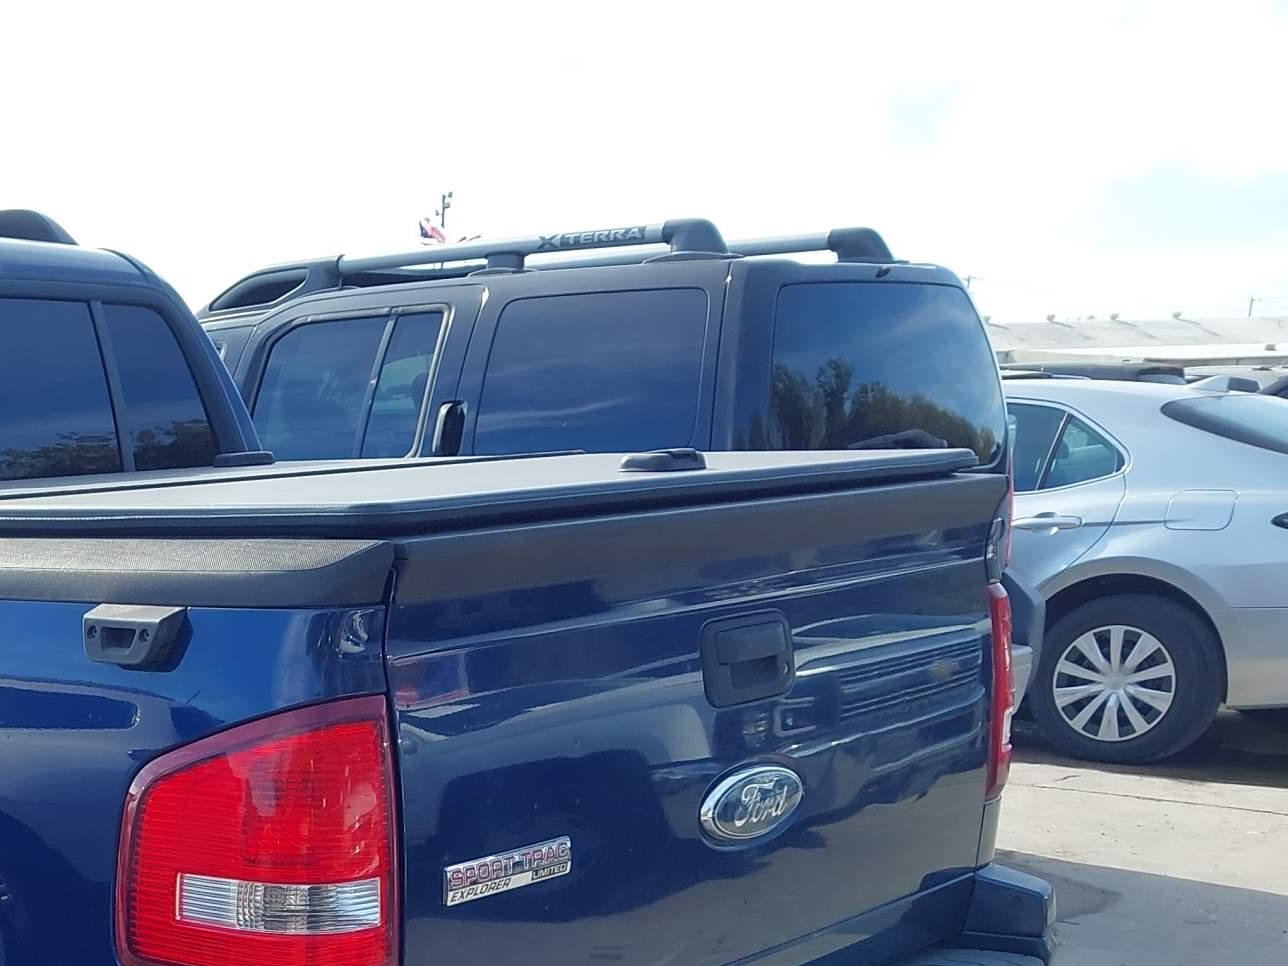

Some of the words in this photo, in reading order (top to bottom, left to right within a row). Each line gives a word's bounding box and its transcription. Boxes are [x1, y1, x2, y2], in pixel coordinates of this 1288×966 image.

[536, 226, 647, 249] XTERRA
[734, 777, 789, 827] Ford
[449, 855, 516, 889] SPORT
[519, 840, 570, 870] TRAC
[532, 862, 568, 879] LIMITED
[450, 877, 512, 903] EXPLORER
